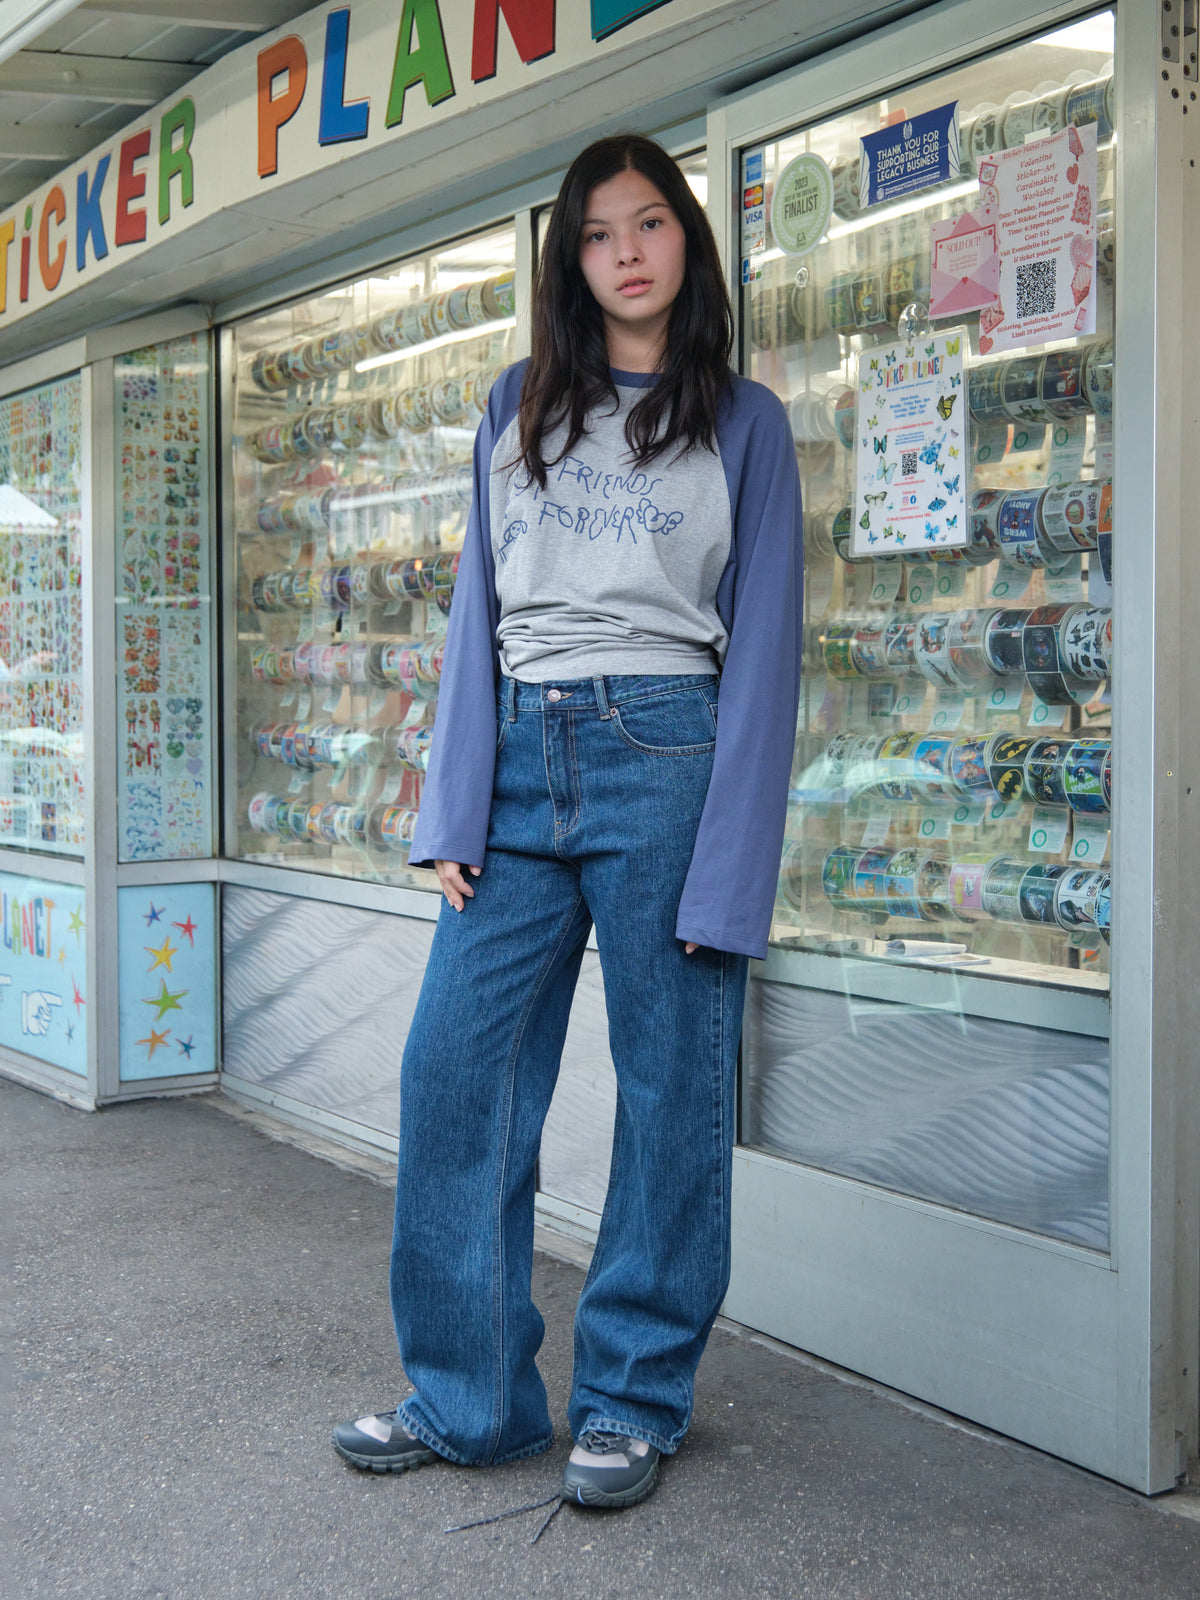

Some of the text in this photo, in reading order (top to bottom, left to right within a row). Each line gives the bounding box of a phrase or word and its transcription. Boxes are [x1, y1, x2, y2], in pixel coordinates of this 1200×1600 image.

[257, 0, 676, 178] PLAN
[877, 130, 939, 160] THANK YOU FOR
[877, 141, 939, 171] SUPPORTING OUR
[1020, 153, 1053, 168] Valentine
[877, 152, 939, 182] LEGACY BUSINESS
[1016, 163, 1055, 181] Sticker-Art
[794, 176, 809, 190] 2023
[1016, 174, 1058, 192] Cardmaking
[1022, 187, 1055, 201] Workshop
[784, 194, 818, 220] FINALIST
[1013, 205, 1037, 216] Tuesday,
[1038, 197, 1061, 208] February
[1018, 213, 1038, 222] Sticker
[1038, 208, 1055, 218] Planet
[1056, 203, 1070, 211] Store
[745, 210, 763, 225] VISA
[1008, 228, 1023, 236] Time:
[1024, 229, 1050, 241] Cost: $15
[1050, 235, 1063, 243] more
[1063, 231, 1075, 239] info
[947, 240, 964, 253] SOLD
[1019, 253, 1035, 262] ticket
[1051, 311, 1060, 319] and
[1012, 330, 1026, 339] Limit
[1033, 322, 1063, 334] participants
[877, 364, 909, 389] STICKER
[912, 355, 945, 380] PLANET
[558, 456, 663, 499] FRIENDS
[0, 887, 56, 959] LANET
